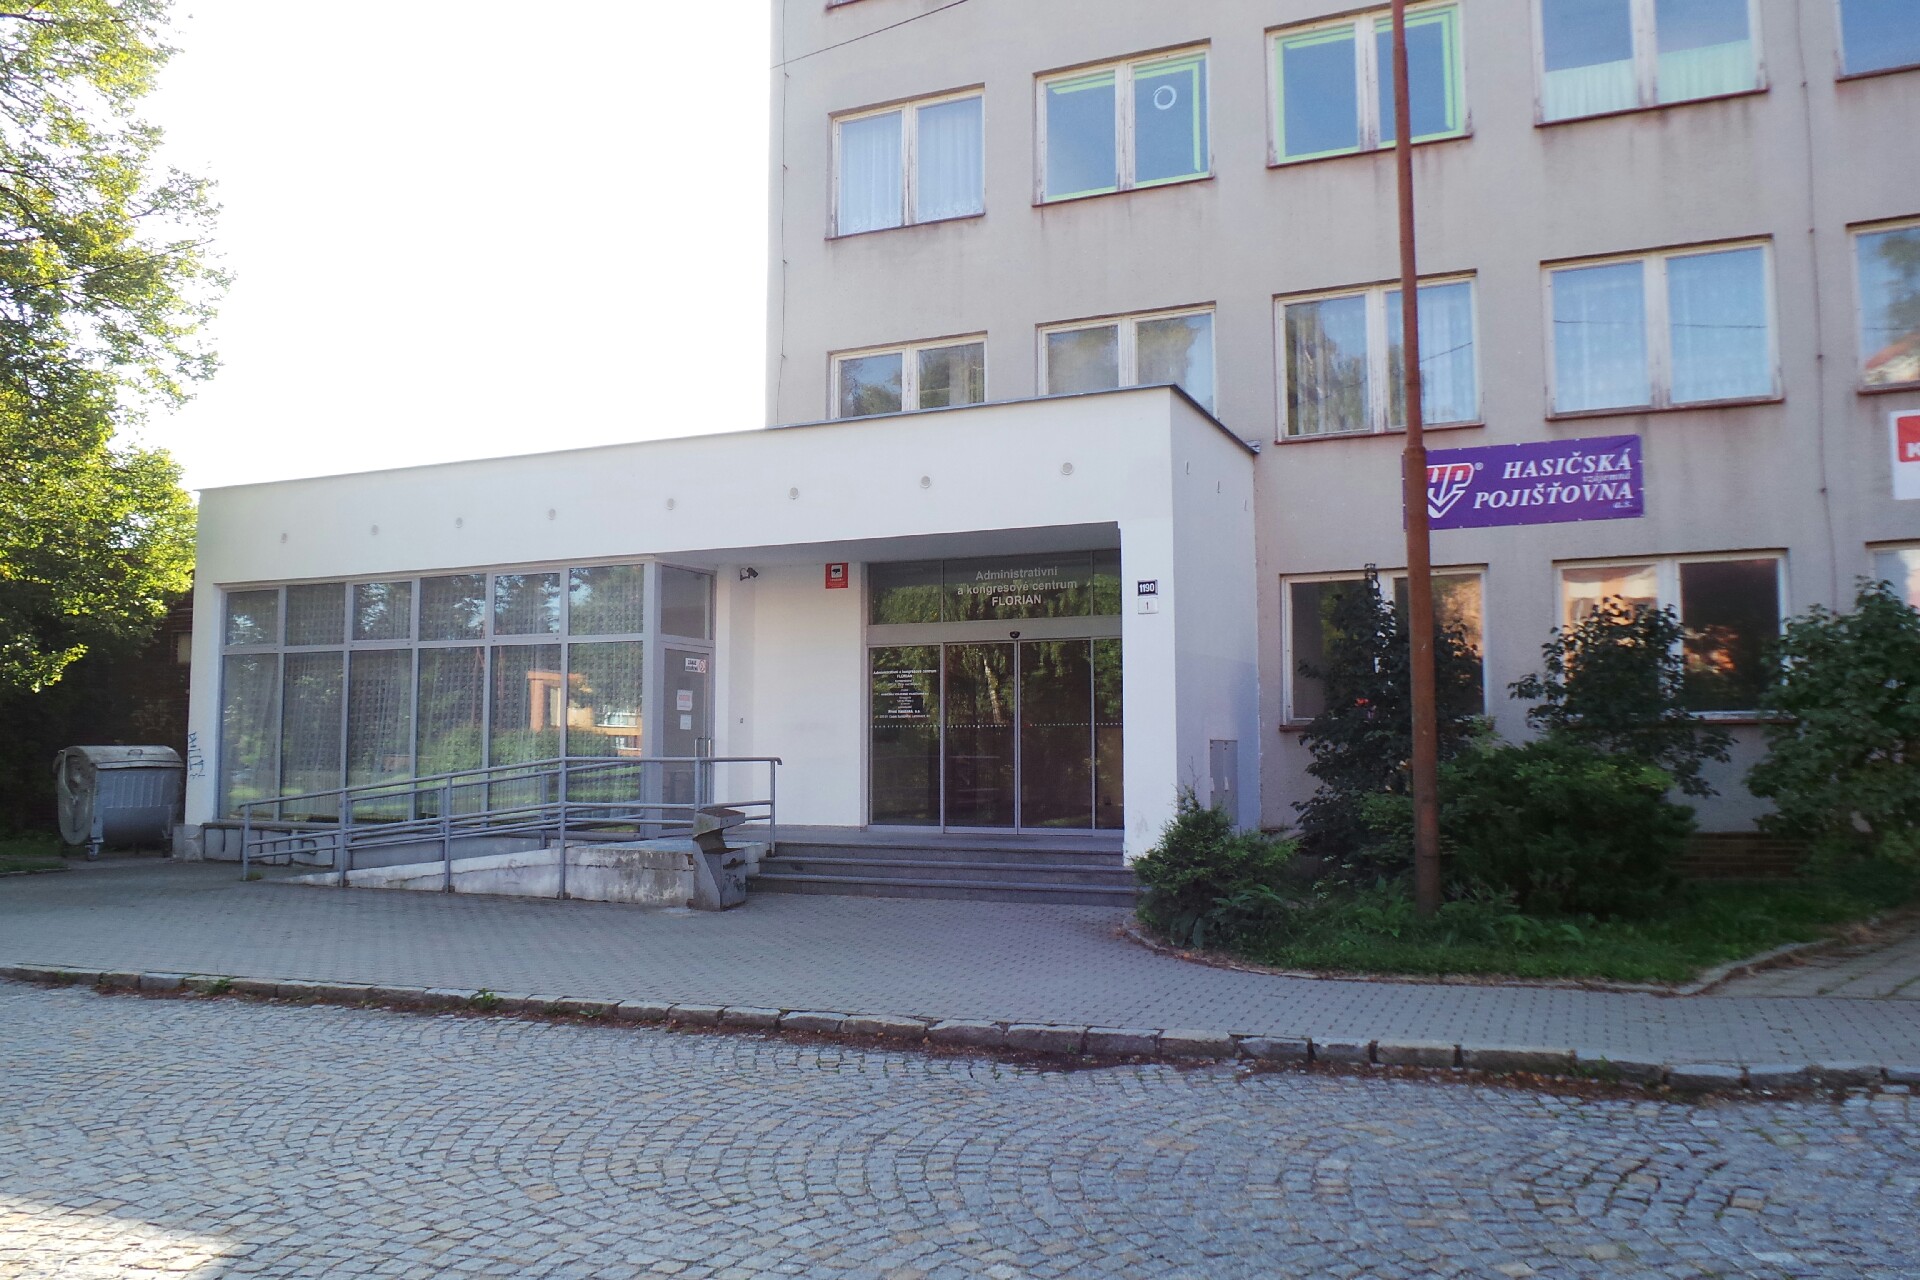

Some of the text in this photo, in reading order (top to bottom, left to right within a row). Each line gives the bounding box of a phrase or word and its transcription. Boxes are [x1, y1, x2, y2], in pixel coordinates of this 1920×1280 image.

[1502, 448, 1633, 479] HASIČSKÁ
[1473, 482, 1635, 509] POJIŠŤOVNA
[975, 566, 1058, 581] Administrativní
[957, 580, 1078, 596] a kongresové centrum
[1139, 583, 1155, 593] 1190
[991, 594, 1042, 607] FLORIAN
